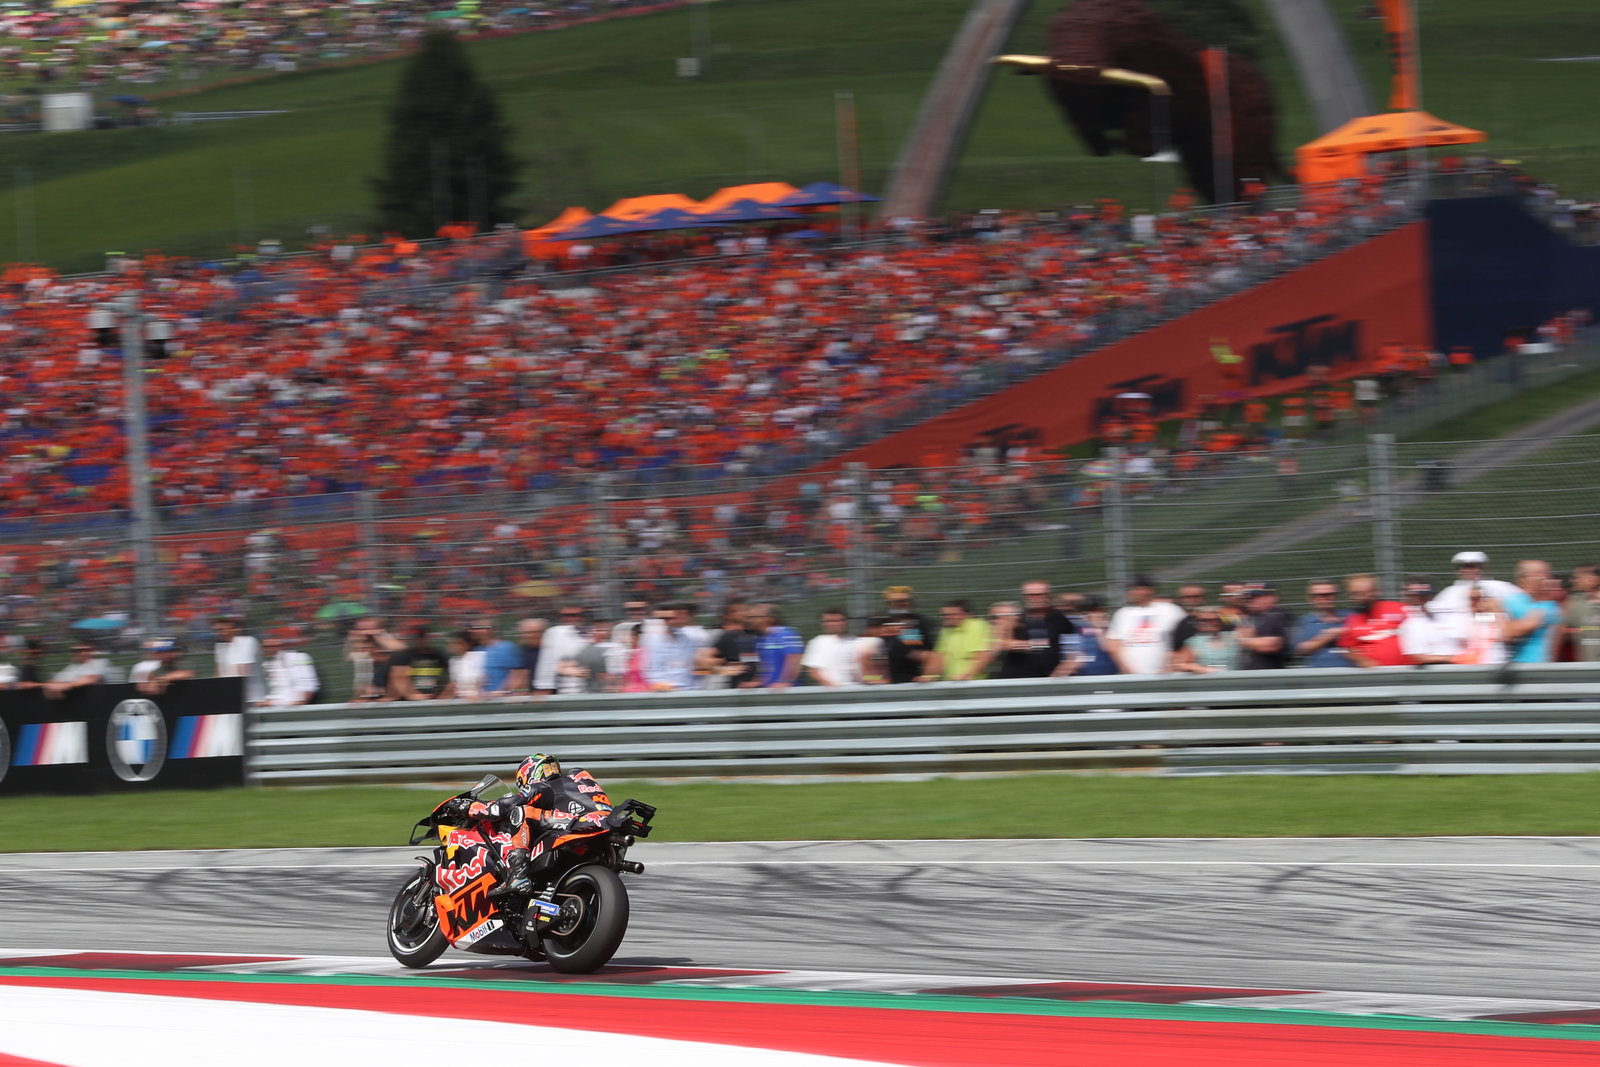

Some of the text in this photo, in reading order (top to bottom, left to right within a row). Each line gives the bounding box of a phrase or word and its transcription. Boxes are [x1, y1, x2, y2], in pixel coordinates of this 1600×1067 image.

[1252, 313, 1364, 386] KTM
[436, 846, 489, 892] Red
[446, 881, 494, 938] KTM
[469, 924, 487, 943] Mobil
